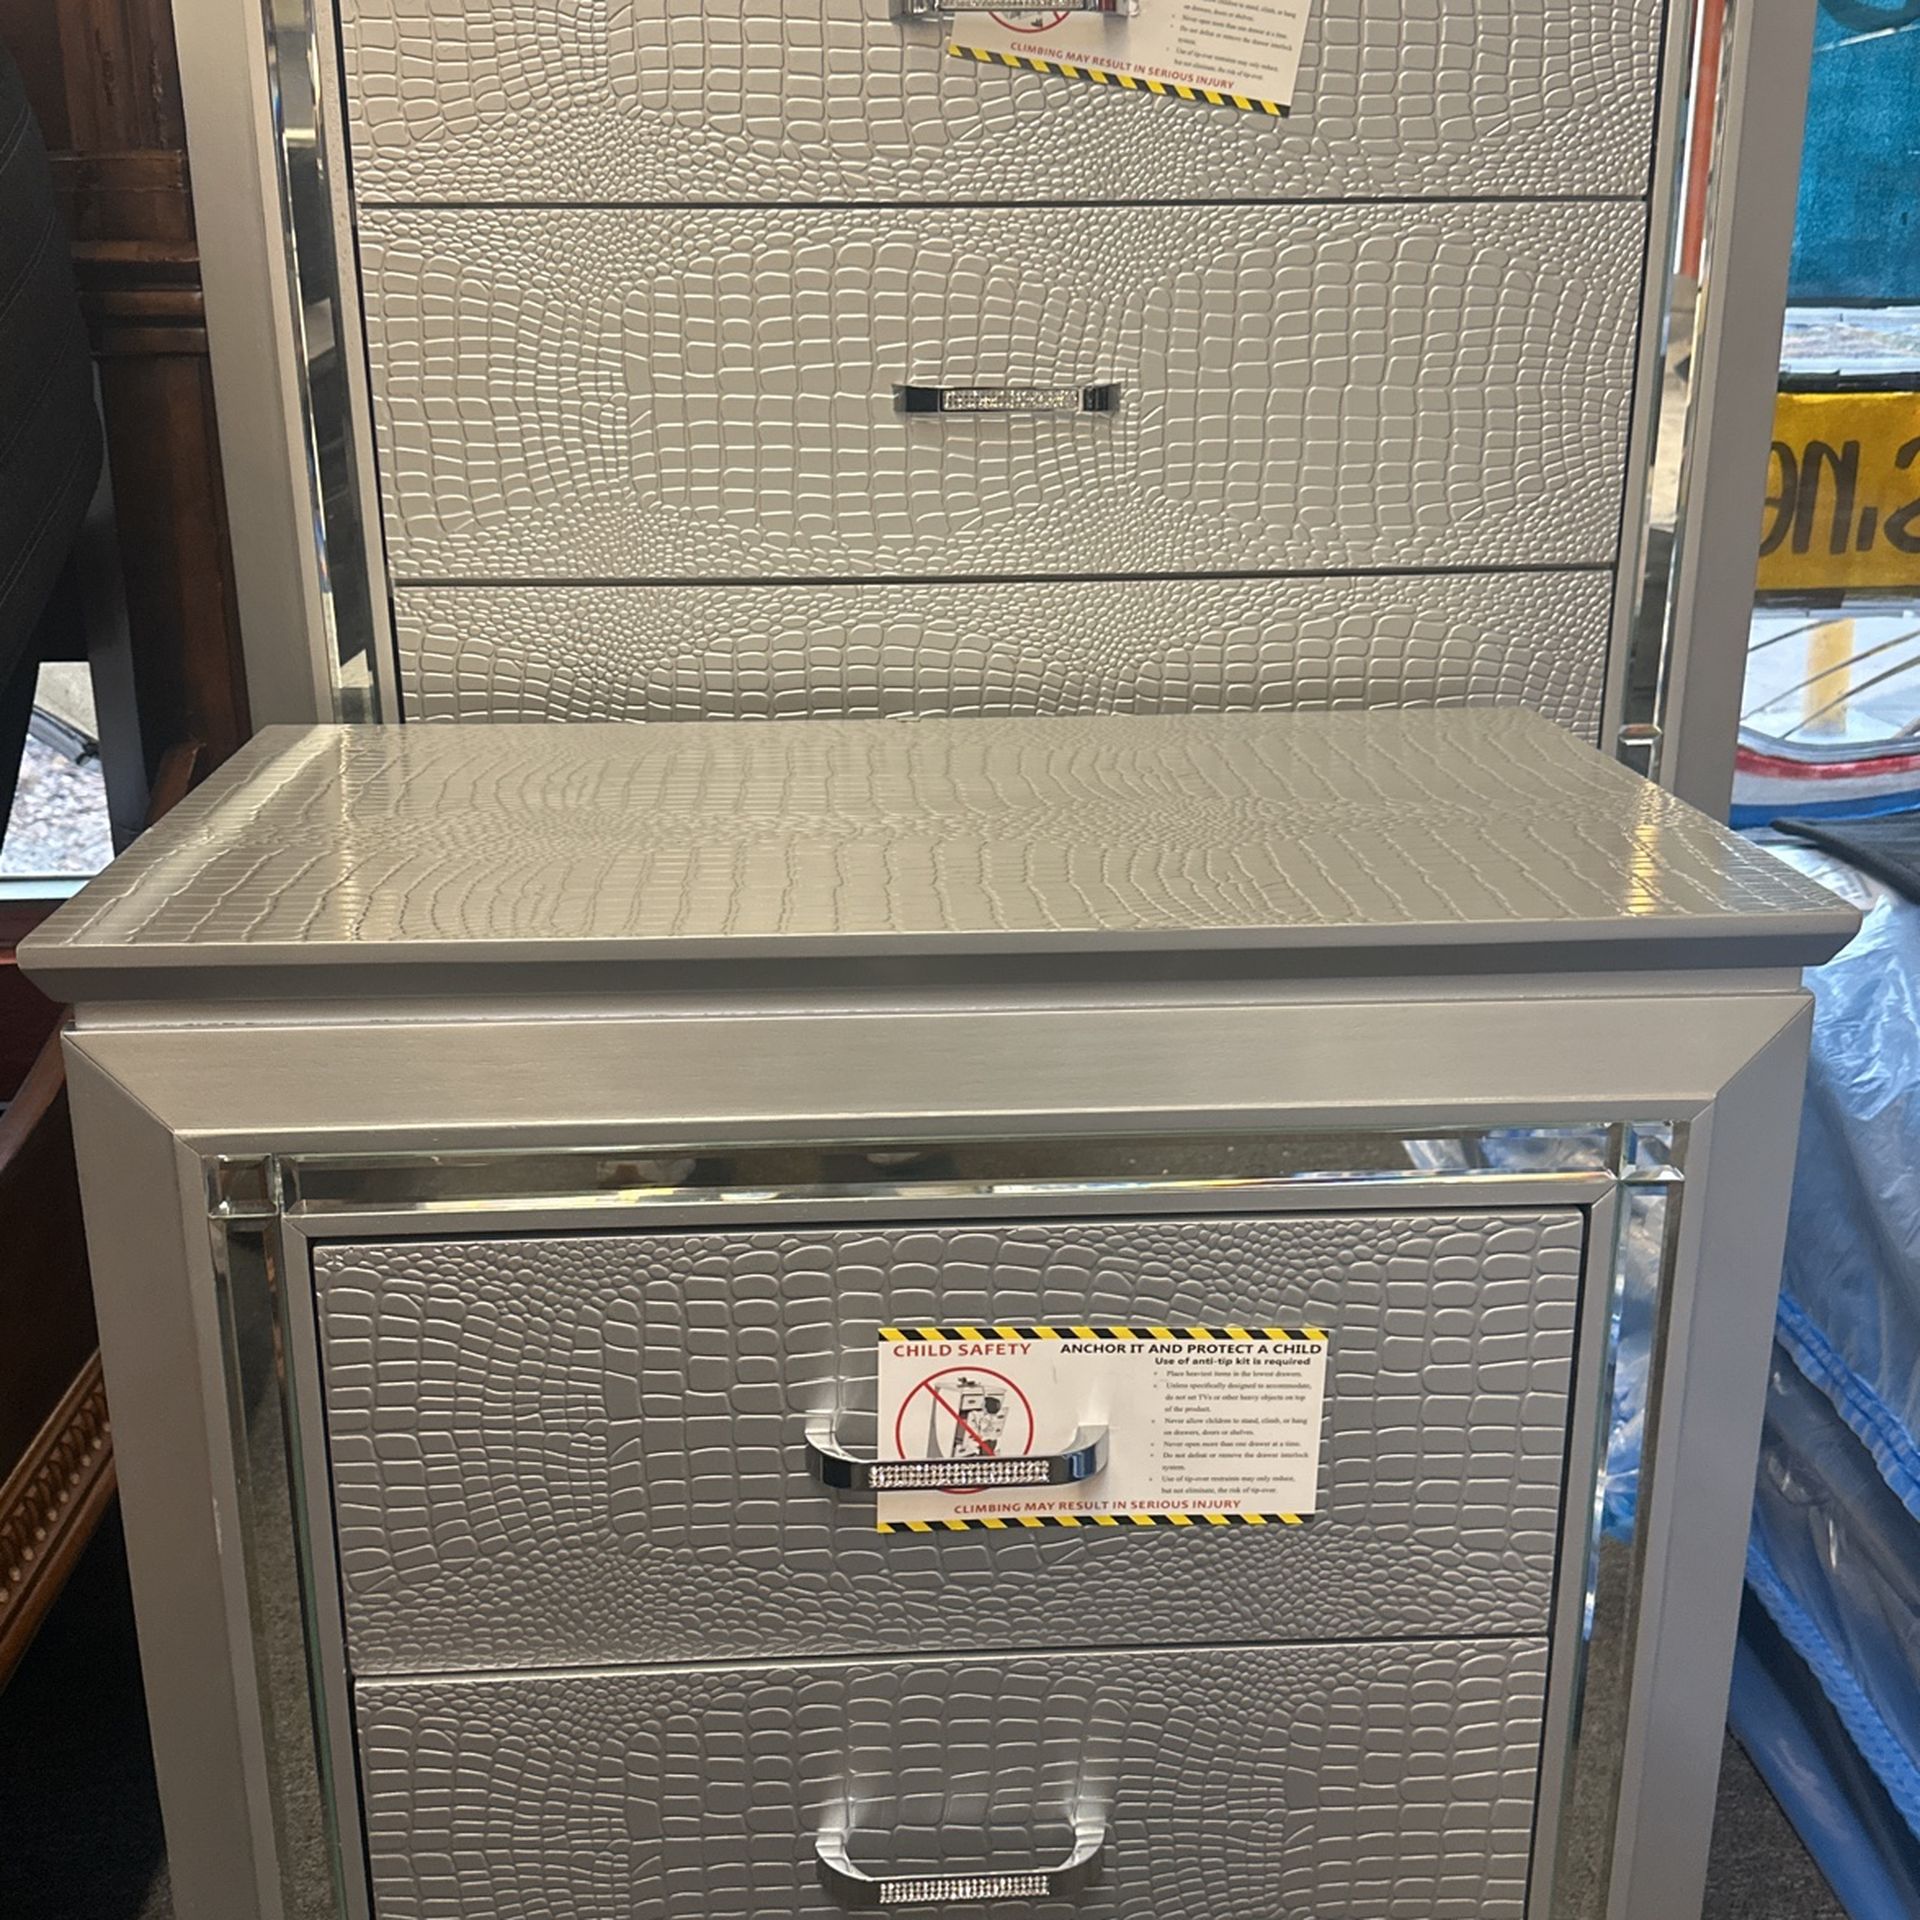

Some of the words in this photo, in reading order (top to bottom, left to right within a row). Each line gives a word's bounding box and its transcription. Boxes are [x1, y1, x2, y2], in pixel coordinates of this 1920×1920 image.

[1010, 42, 1062, 58] CLIMBING
[1065, 51, 1090, 62] MAY
[1091, 56, 1131, 70] RESULT
[1133, 64, 1145, 73] IN
[1147, 66, 1193, 82] SERIOUS
[1195, 75, 1234, 88] INJURY
[893, 1344, 951, 1357] CHILD
[958, 1343, 1031, 1356] SAFETY
[1060, 1343, 1126, 1353] ANCHOR
[1130, 1344, 1144, 1353] IT
[1148, 1344, 1182, 1353] AND
[1187, 1344, 1253, 1353] PROTECT
[1257, 1344, 1268, 1353] A
[1272, 1344, 1321, 1354] CHILD
[1177, 1356, 1189, 1364] of
[1192, 1357, 1232, 1366] anti-tip
[1264, 1357, 1310, 1366] required
[953, 1502, 1020, 1513] CLIMBING
[1024, 1501, 1055, 1510] MAY
[1058, 1500, 1110, 1511] RESULT
[1112, 1500, 1126, 1509] IN
[1130, 1499, 1188, 1510] SERIOUS
[1192, 1500, 1240, 1508] INJURY
